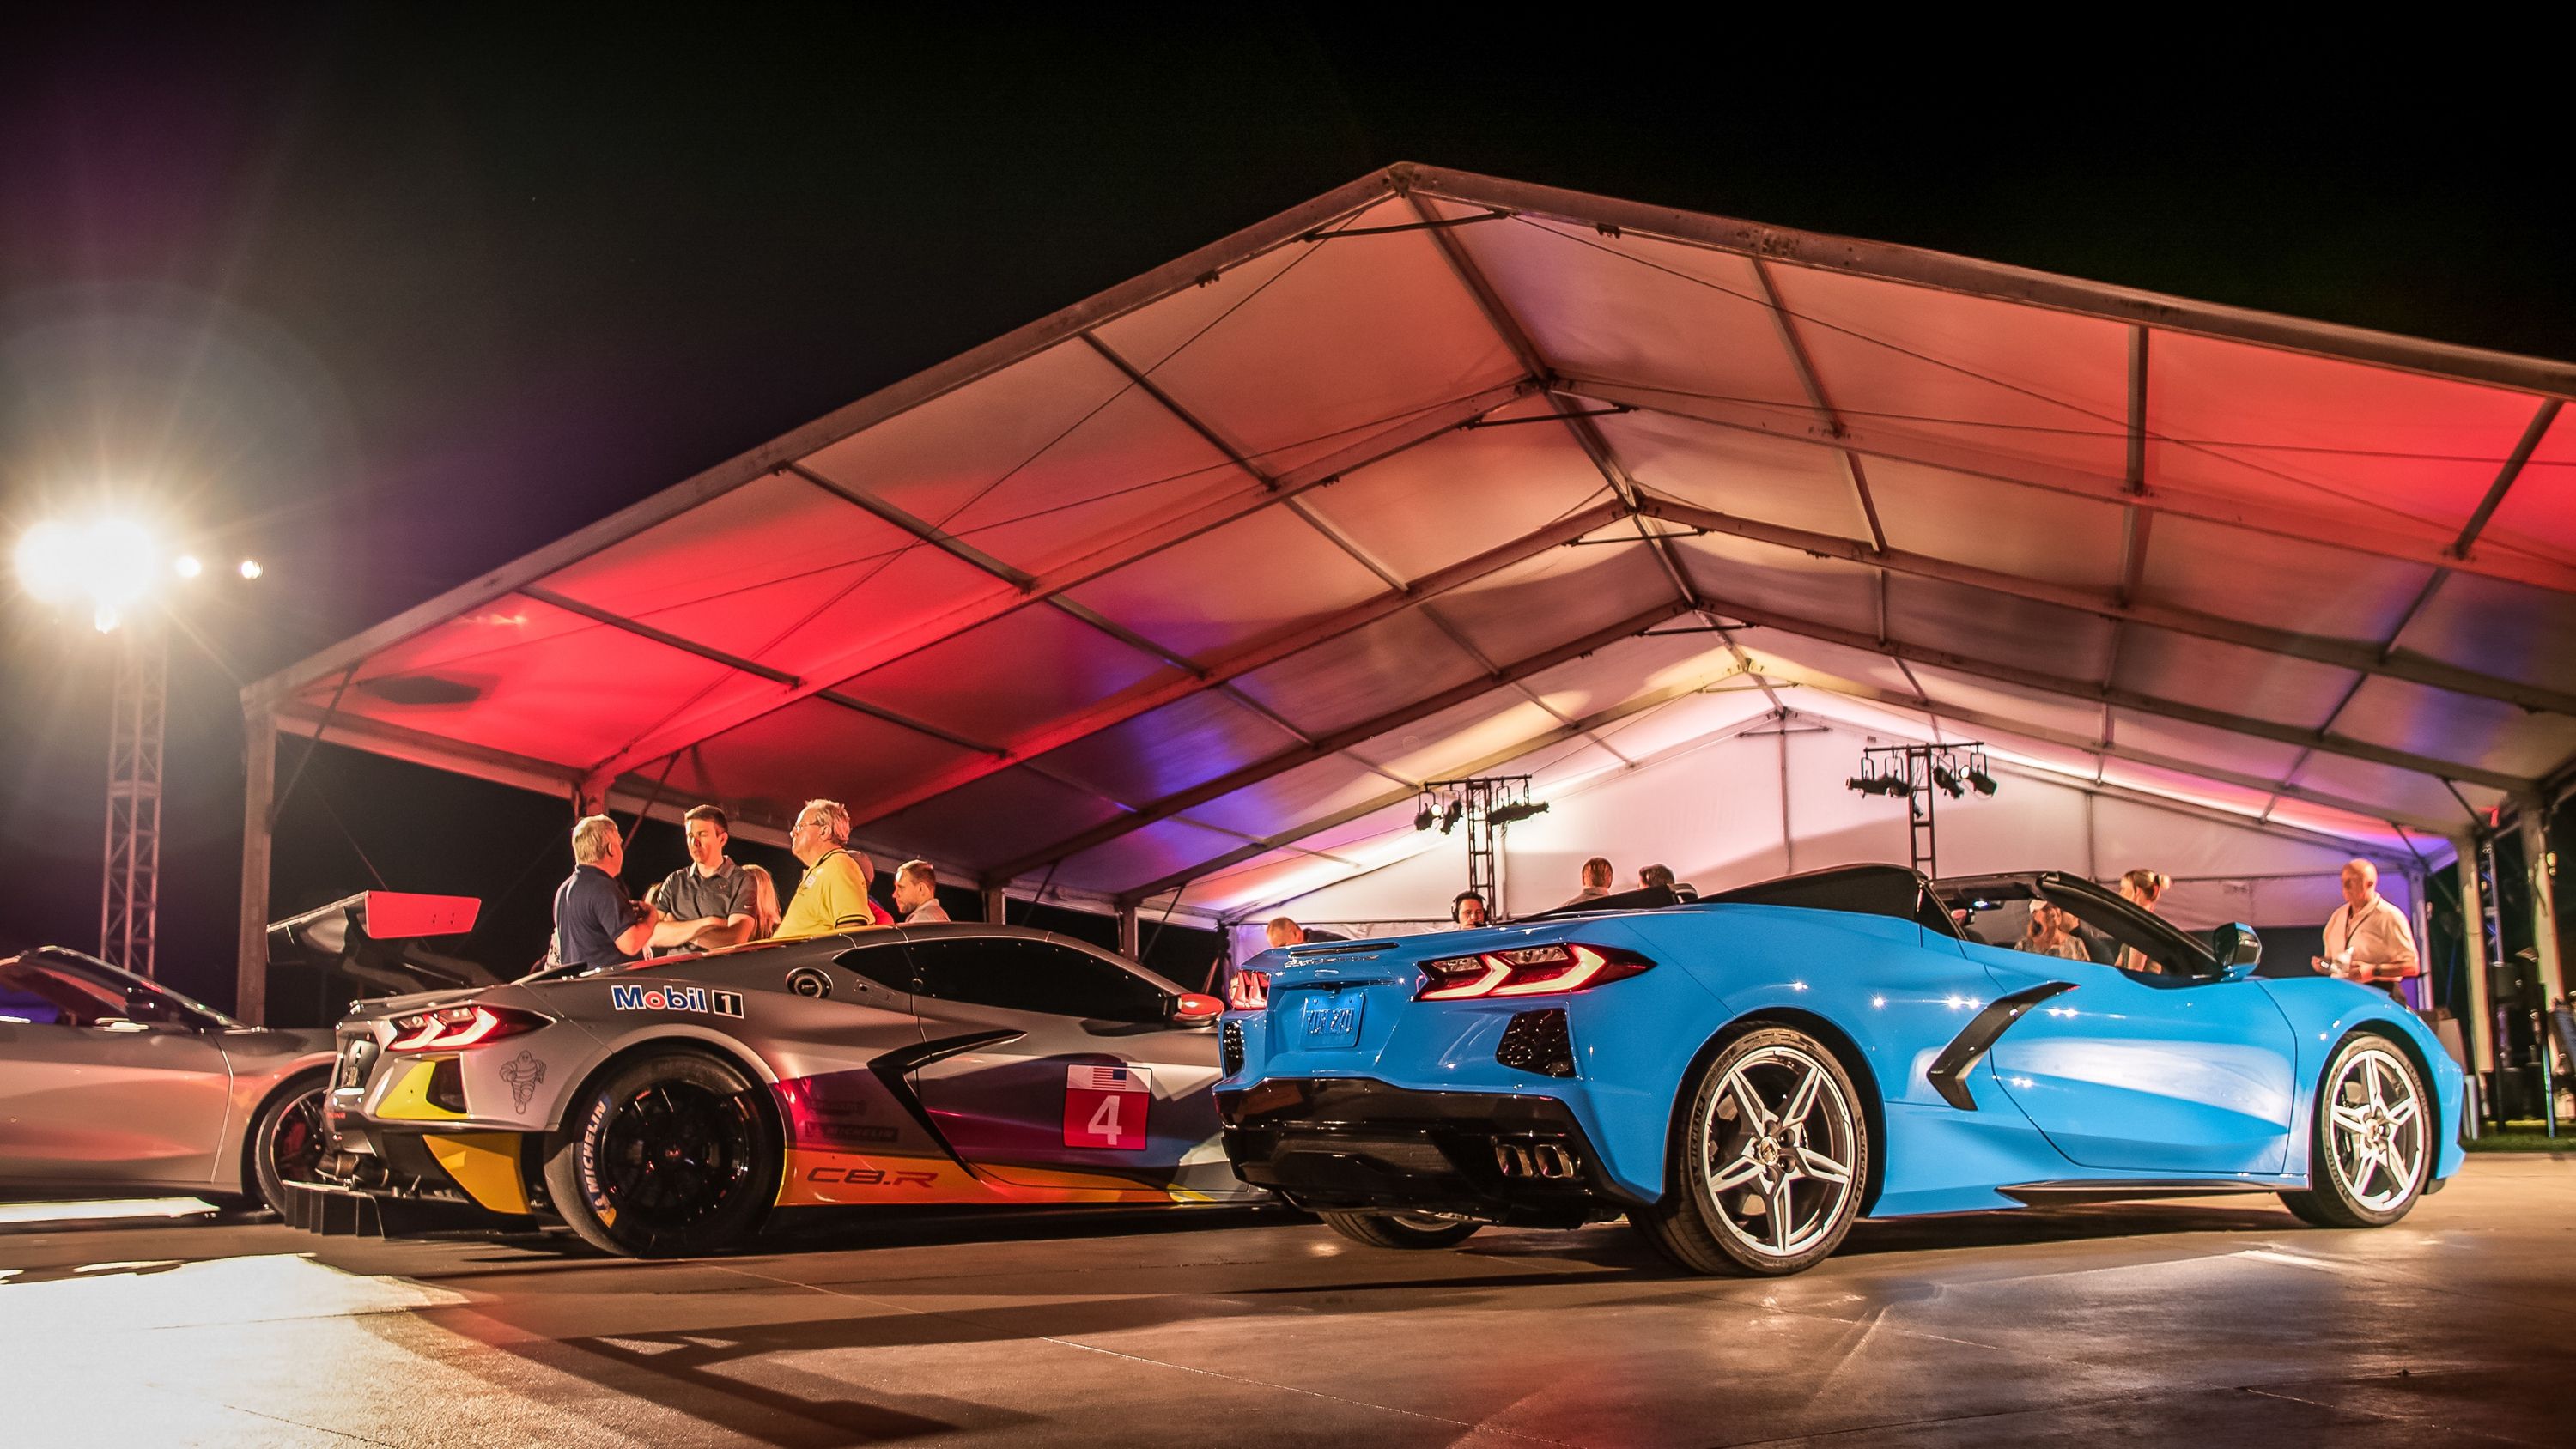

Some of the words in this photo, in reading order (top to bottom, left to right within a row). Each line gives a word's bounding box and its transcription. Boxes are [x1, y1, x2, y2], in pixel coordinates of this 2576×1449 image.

[611, 985, 708, 1013] Mobil
[721, 995, 732, 1014] 1
[1087, 1094, 1122, 1145] 4
[583, 1100, 607, 1194] MICHELIN
[807, 1167, 939, 1188] C8.R
